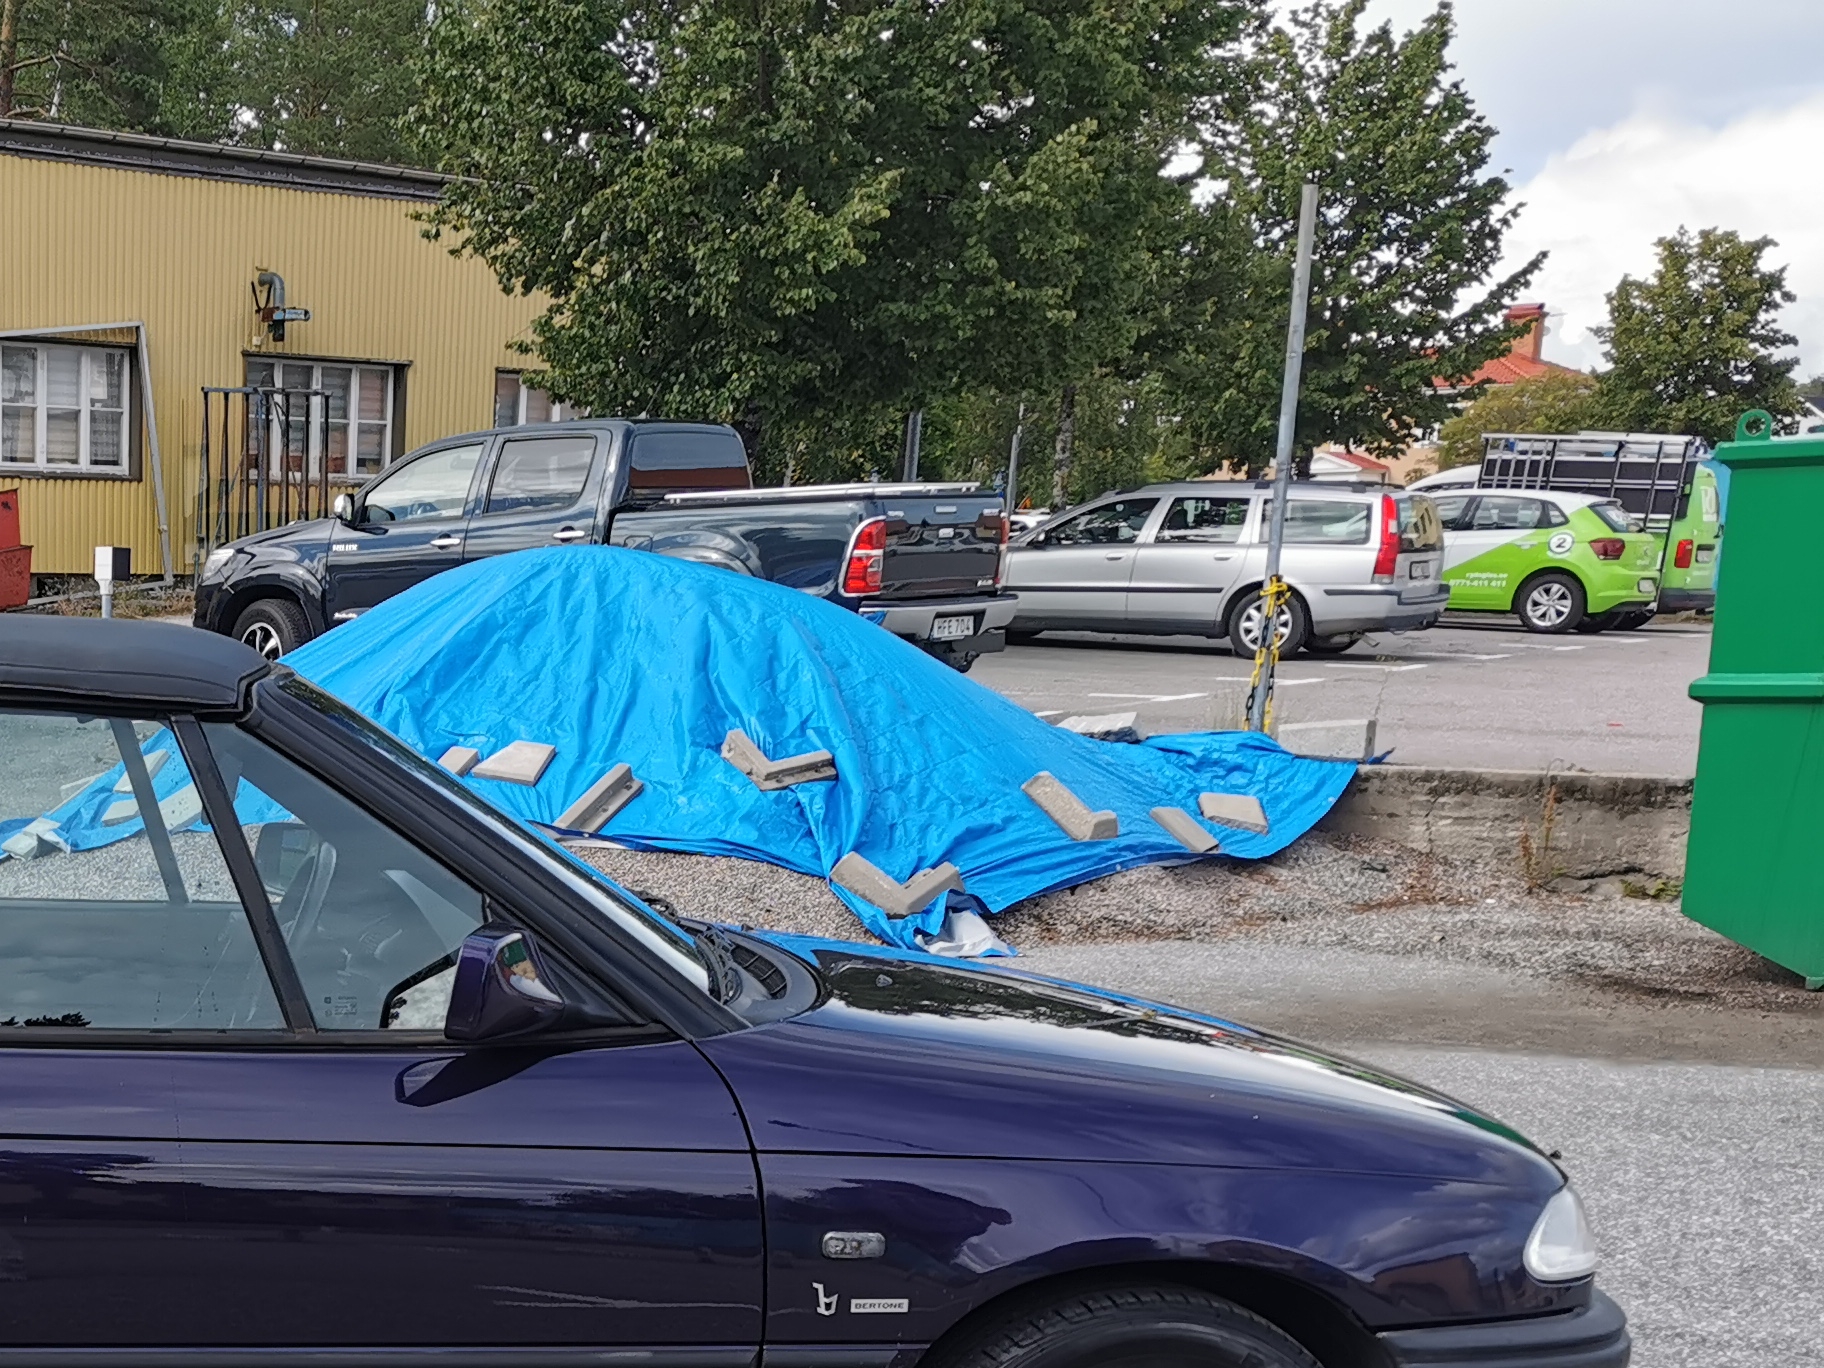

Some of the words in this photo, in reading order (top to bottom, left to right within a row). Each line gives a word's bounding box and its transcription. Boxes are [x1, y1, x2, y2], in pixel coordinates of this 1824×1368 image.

[1554, 537, 1567, 549] 2
[955, 618, 970, 634] 704
[854, 1302, 905, 1310] BERTONE
